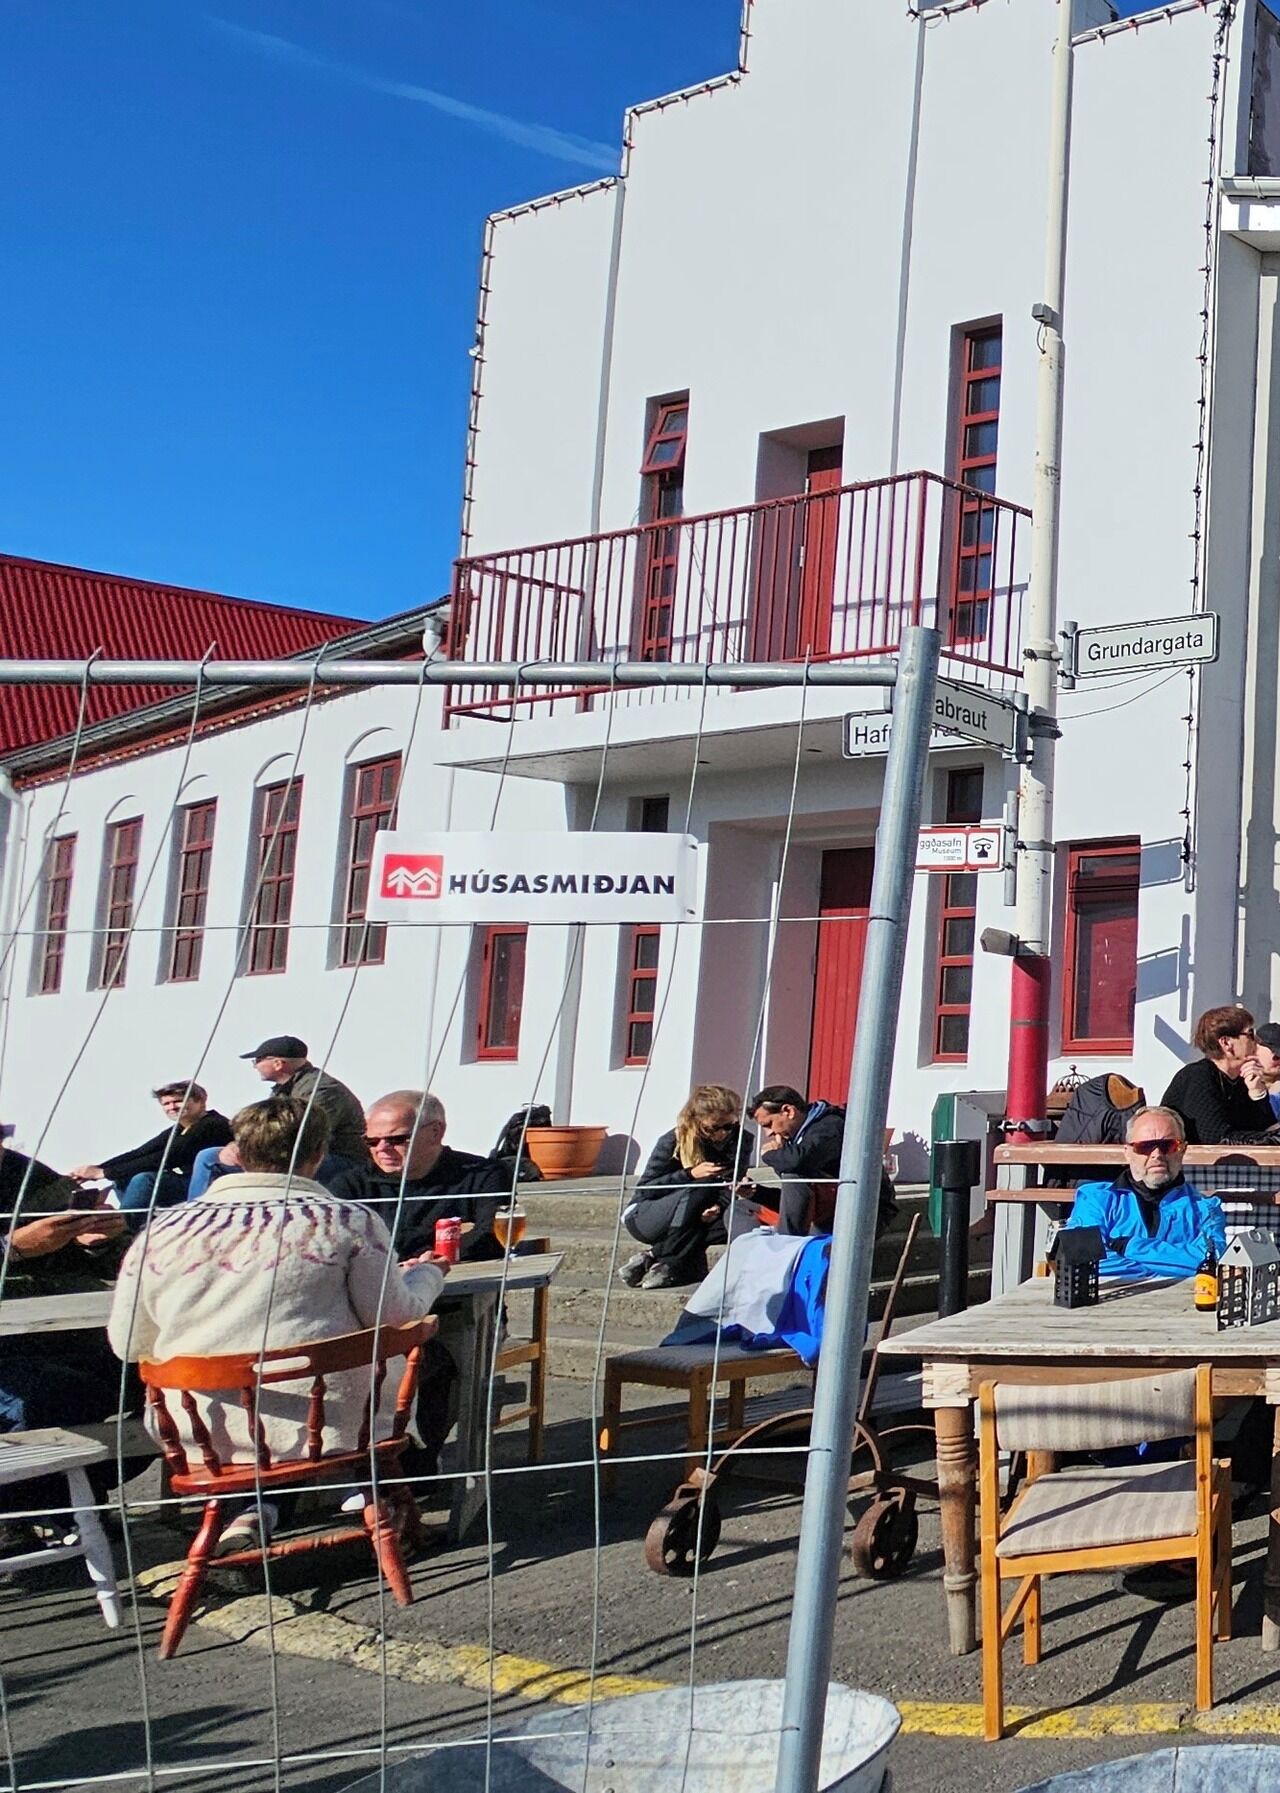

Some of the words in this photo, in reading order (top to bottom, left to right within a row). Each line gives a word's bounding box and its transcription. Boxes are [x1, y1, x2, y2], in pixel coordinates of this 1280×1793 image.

[1087, 632, 1203, 662] Grundargata
[935, 696, 988, 731] abraut
[919, 838, 962, 850] ggðasafn
[448, 868, 675, 895] HÚSASMIÐJAN
